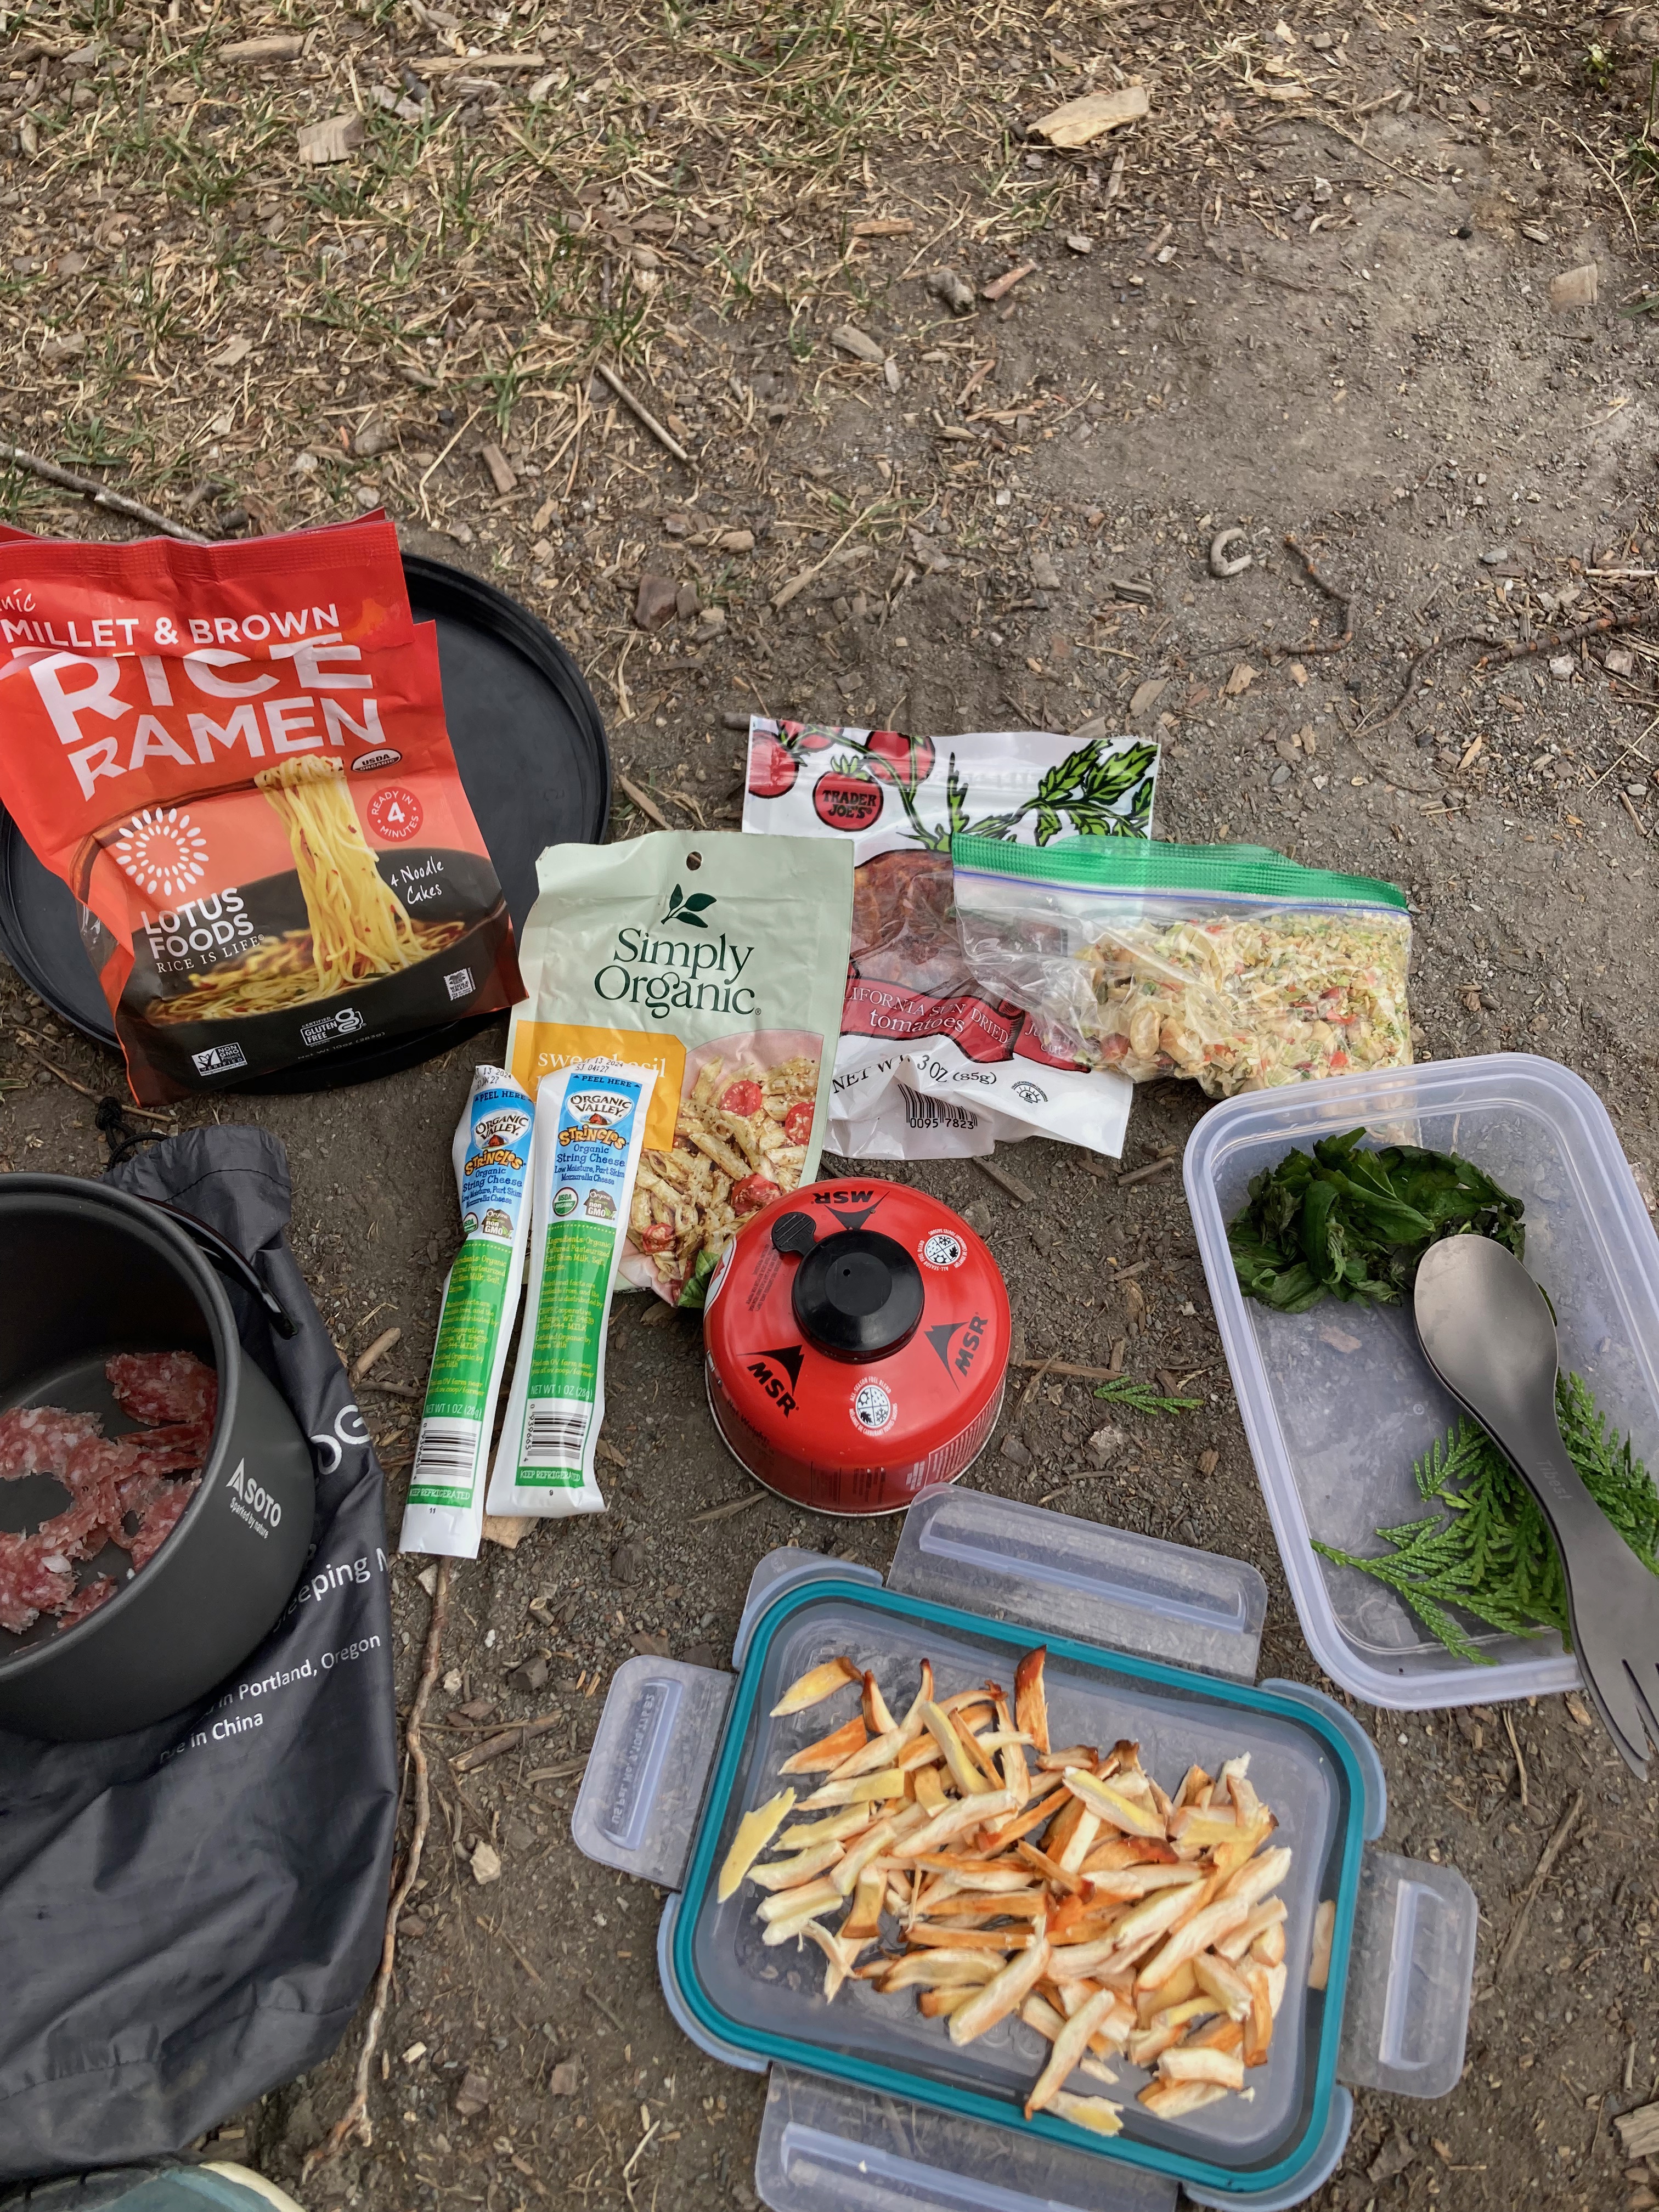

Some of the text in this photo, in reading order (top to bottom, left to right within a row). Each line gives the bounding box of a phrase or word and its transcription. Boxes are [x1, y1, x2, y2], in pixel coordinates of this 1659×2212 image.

[1, 603, 340, 647] MILLET & BROWN
[11, 633, 373, 745] RICE
[67, 697, 386, 802] RAMEN
[360, 759, 395, 770] ORGANIC
[362, 754, 390, 765] USDA
[371, 791, 413, 815] READY IN
[822, 790, 877, 806] TRADER
[387, 802, 405, 823] 4
[827, 804, 867, 819] JOE'S
[380, 815, 419, 838] MINUTES
[390, 856, 445, 887] 4 Noodle
[407, 883, 443, 904] Cakes
[141, 888, 245, 935] LOTUS
[149, 913, 255, 959] FOODS
[156, 959, 194, 973] RICE
[200, 952, 217, 965] IS
[613, 928, 755, 985] Simply
[302, 1017, 331, 1028] CERTIFIED
[304, 1020, 338, 1036] GLUTEN
[870, 1009, 966, 1033] tomatoes
[929, 1003, 967, 1017] SUN
[970, 1007, 1009, 1044] DRIED
[307, 1031, 328, 1043] FREE
[218, 1045, 237, 1053] NON
[219, 1049, 239, 1057] GMO
[201, 1058, 242, 1071] VERIFIED
[495, 1069, 511, 1079] 2024
[832, 1066, 872, 1094] NET
[917, 1054, 930, 1070] 3
[929, 1062, 949, 1083] OZ
[952, 1071, 997, 1085] (85g)
[607, 1078, 632, 1087] HERE
[479, 1090, 526, 1102] PEEL HERE
[571, 1095, 632, 1109] ORGANIC
[575, 1103, 625, 1116] VALLEY
[475, 1115, 529, 1135] ORGANIC
[909, 1117, 974, 1130] 0095 7823
[574, 1144, 610, 1154] Organic
[556, 1153, 625, 1167] String Cheese
[476, 1167, 506, 1177] Organic
[554, 1164, 625, 1178] Low Moisture, Part Skim
[462, 1175, 523, 1192] String Cheese
[561, 1173, 614, 1185] Mozzarella Cheese
[490, 1194, 512, 1204] Cheese
[493, 1186, 506, 1194] Part
[507, 1187, 522, 1198] Skim
[815, 1190, 874, 1205] MSR
[588, 1207, 606, 1217] GMO
[485, 1226, 503, 1235] GMO
[586, 1237, 612, 1248] Organic
[571, 1244, 610, 1257] Pasteurized
[953, 1316, 989, 1377] MSR
[531, 1384, 593, 1400] NET WT 1 OZ (28g)
[747, 1362, 797, 1419] MSR
[878, 1379, 891, 1394] BLEND
[435, 1403, 446, 1413] WT
[447, 1404, 450, 1413] 1
[452, 1404, 464, 1414] OZ
[520, 1470, 580, 1481] KEEP REFRIGERATED
[1536, 1459, 1573, 1500] Tibest
[230, 1497, 269, 1539] Sparked by nature
[239, 1659, 318, 1701] Portland,
[321, 1635, 381, 1669] Oregon
[190, 1712, 263, 1748] in China
